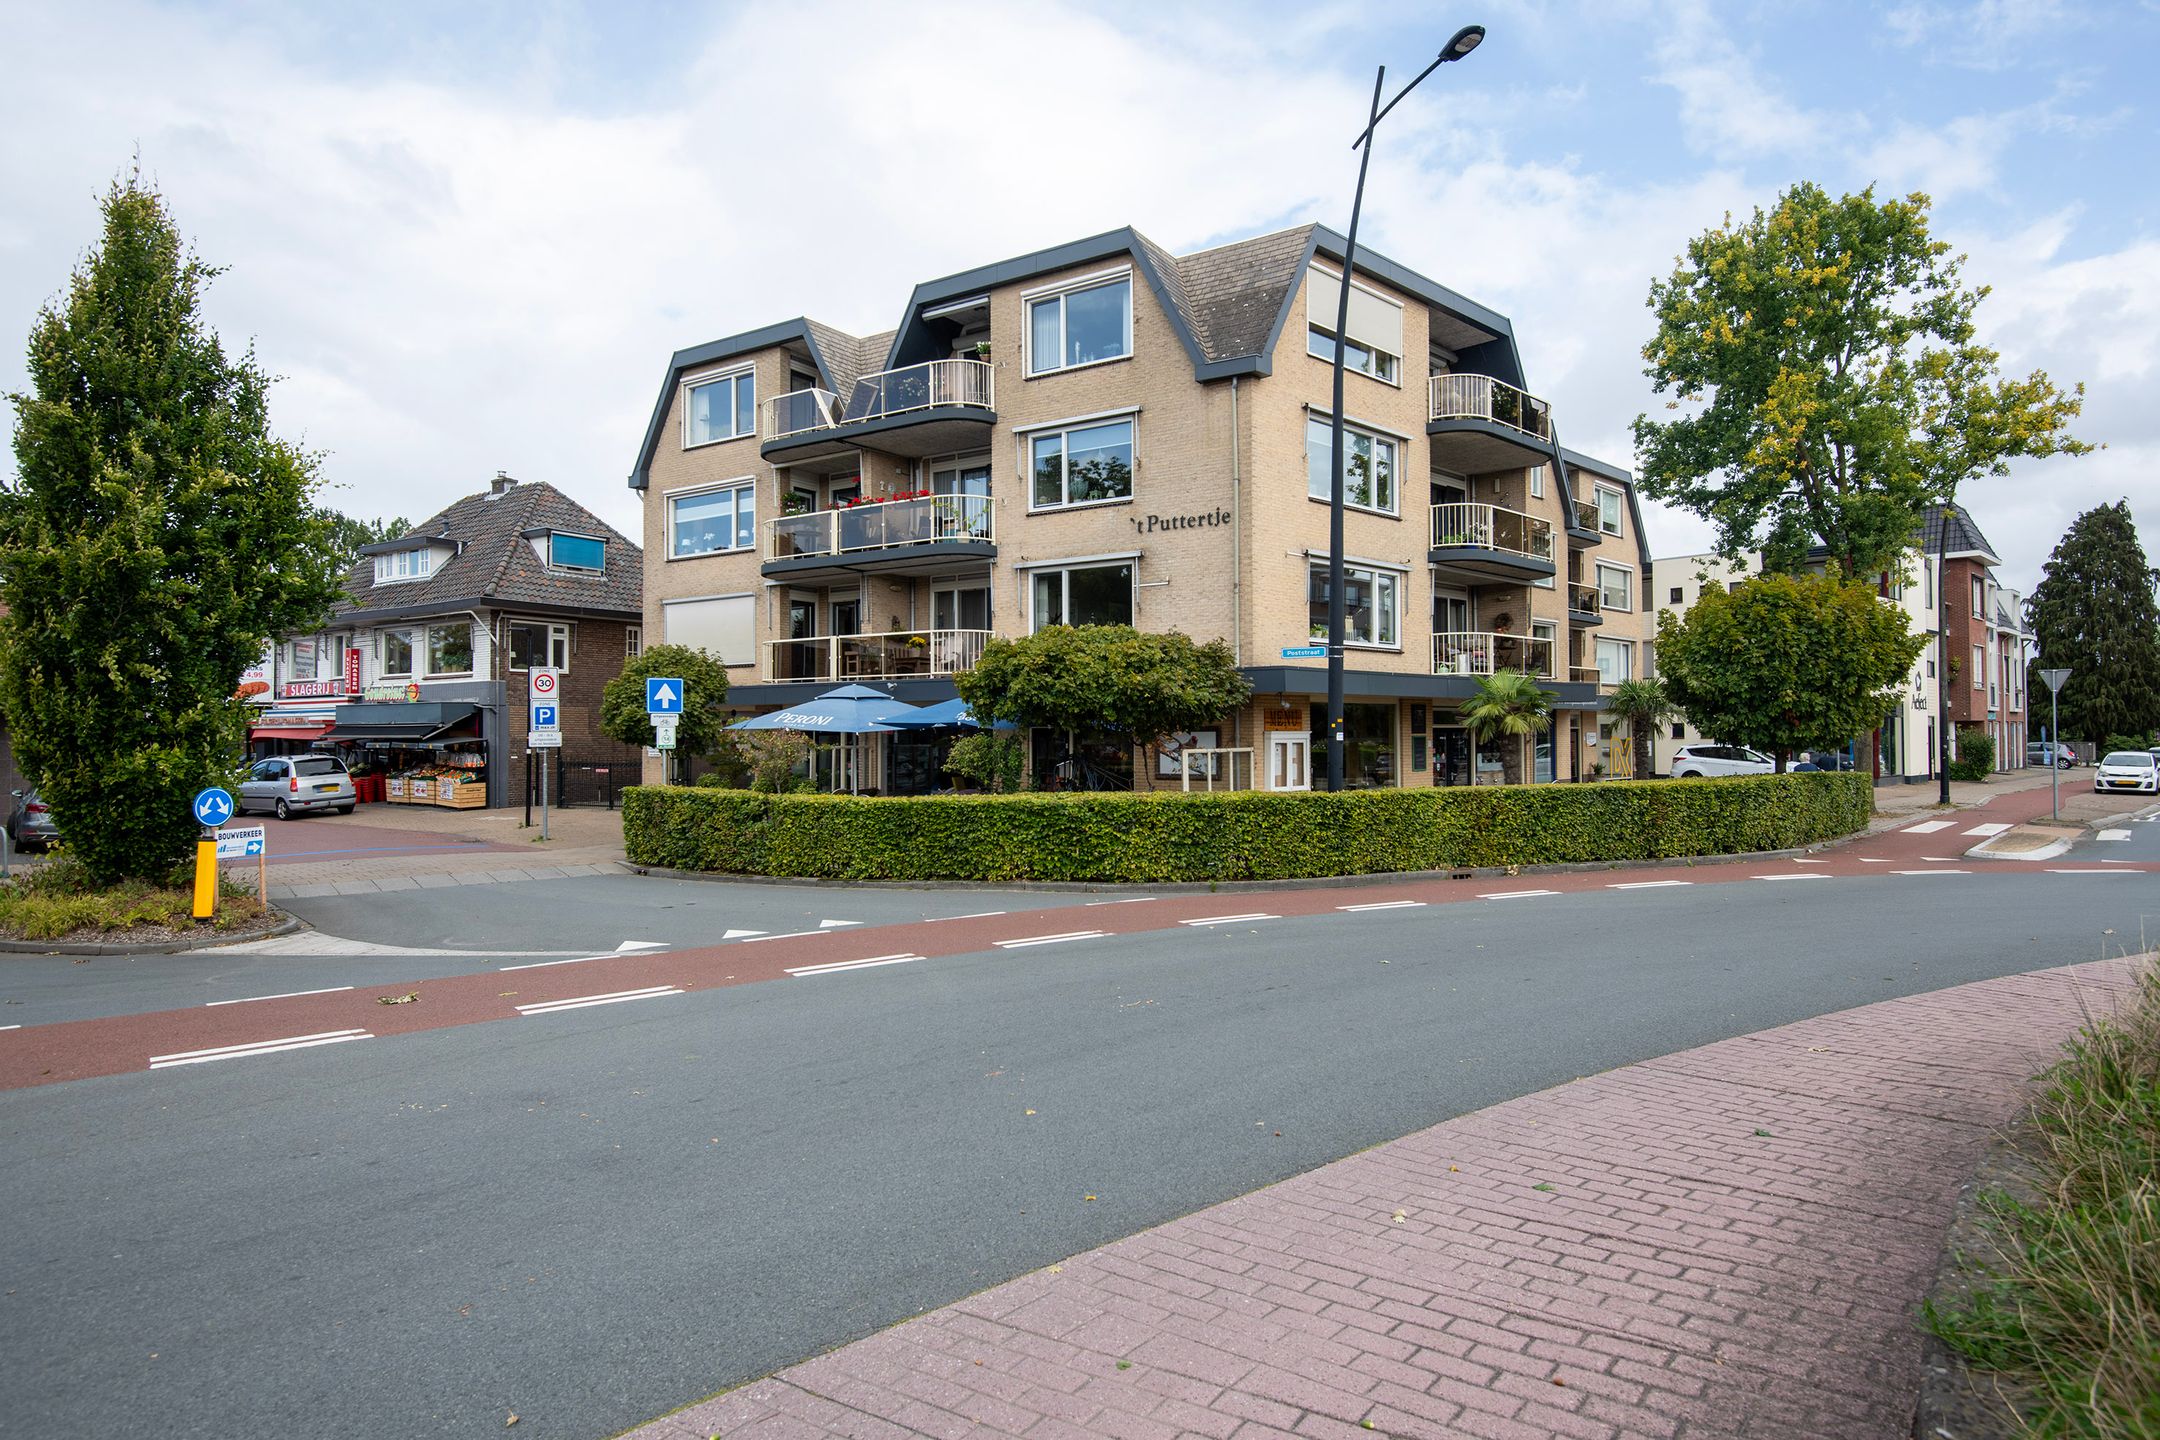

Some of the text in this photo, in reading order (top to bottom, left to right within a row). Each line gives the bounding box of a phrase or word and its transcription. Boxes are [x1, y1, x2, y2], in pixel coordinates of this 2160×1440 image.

[1147, 507, 1231, 532] Puttertje
[351, 655, 359, 690] TOMASSEN
[290, 683, 330, 696] SLAGERIJ
[538, 679, 552, 688] 30
[539, 708, 551, 723] P
[774, 712, 833, 726] PERONI
[217, 829, 263, 841] BOUWVERKEER
